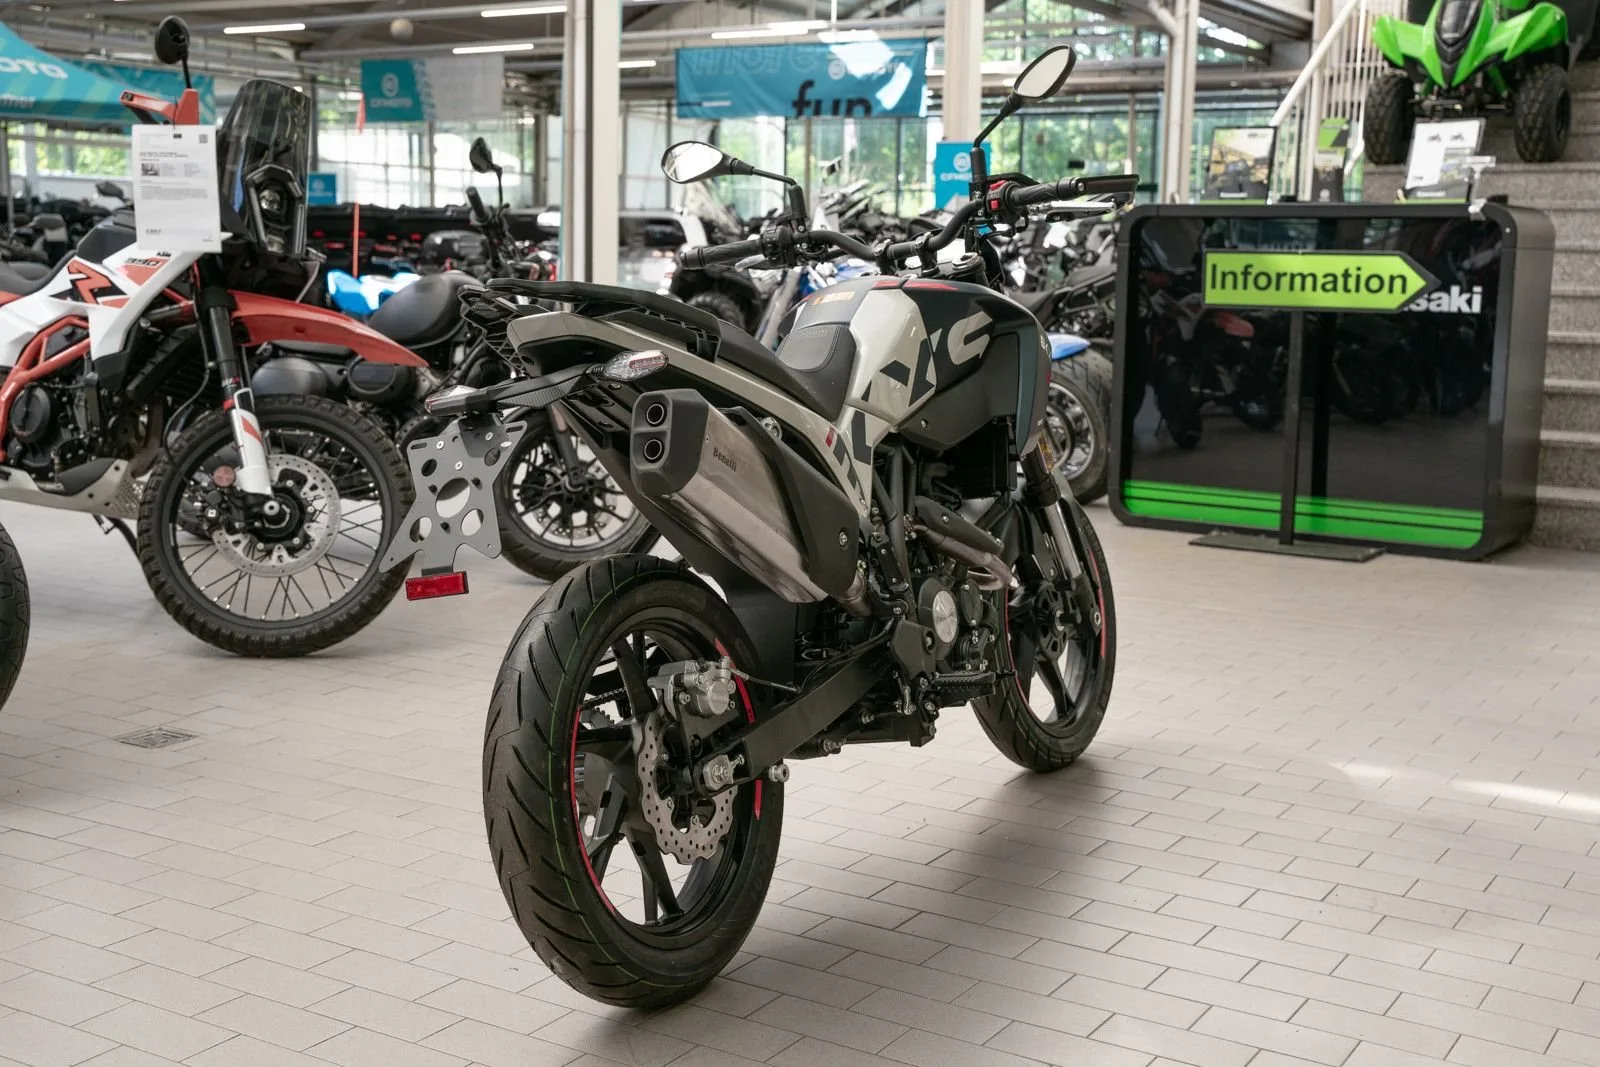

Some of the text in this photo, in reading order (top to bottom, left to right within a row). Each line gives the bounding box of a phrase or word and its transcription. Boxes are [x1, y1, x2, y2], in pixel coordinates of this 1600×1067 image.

[1210, 263, 1407, 294] Information
[1404, 286, 1483, 313] saki
[712, 446, 737, 473] Benelli
